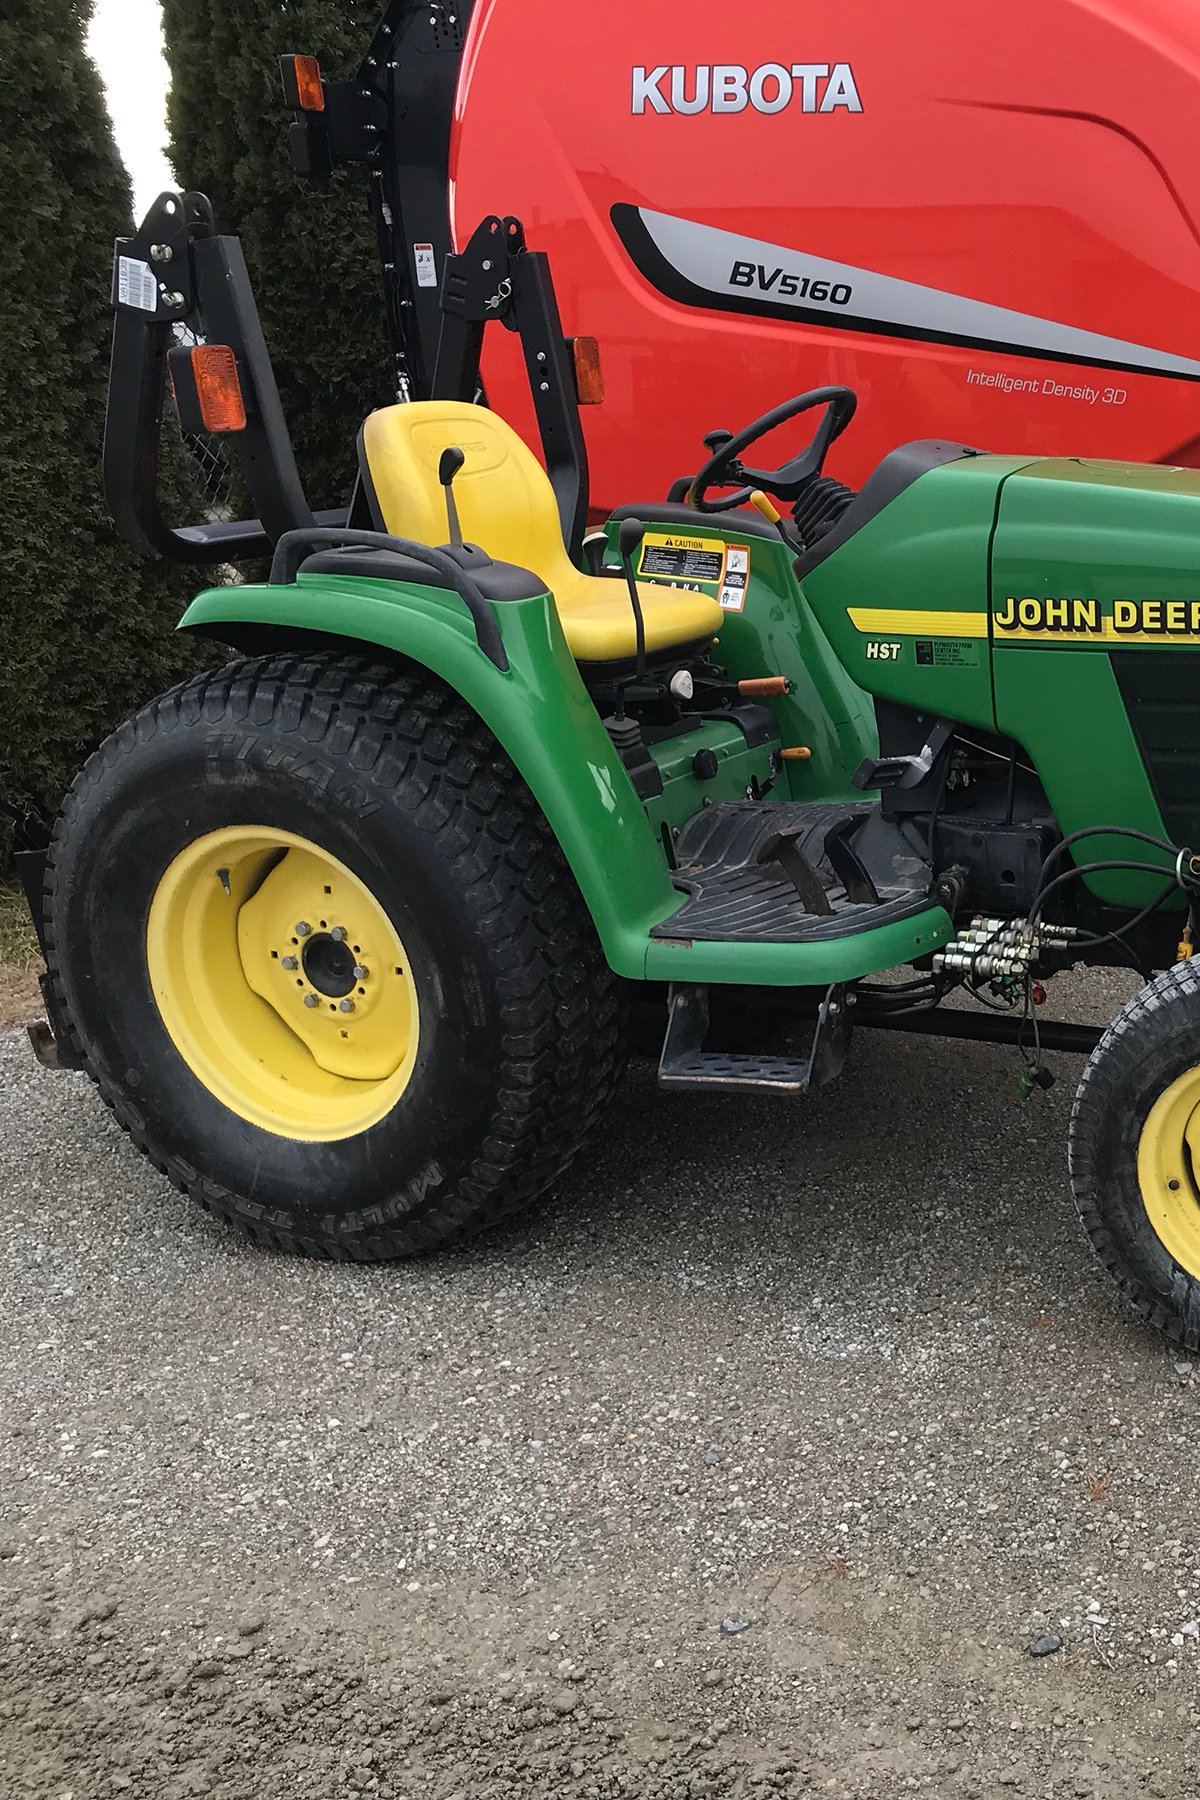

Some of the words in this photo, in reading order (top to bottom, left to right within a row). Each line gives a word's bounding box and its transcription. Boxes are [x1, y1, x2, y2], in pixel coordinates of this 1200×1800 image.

[631, 62, 864, 116] KUBOTA
[728, 261, 853, 306] BV5160
[966, 368, 1040, 397] Intelligent
[1043, 378, 1100, 406] Density
[1102, 388, 1127, 406] 3D
[674, 539, 703, 550] CAUTION
[995, 597, 1104, 633] JOHN
[866, 641, 902, 661] HST
[202, 733, 384, 819] TITAN
[320, 1160, 446, 1233] MULTI
